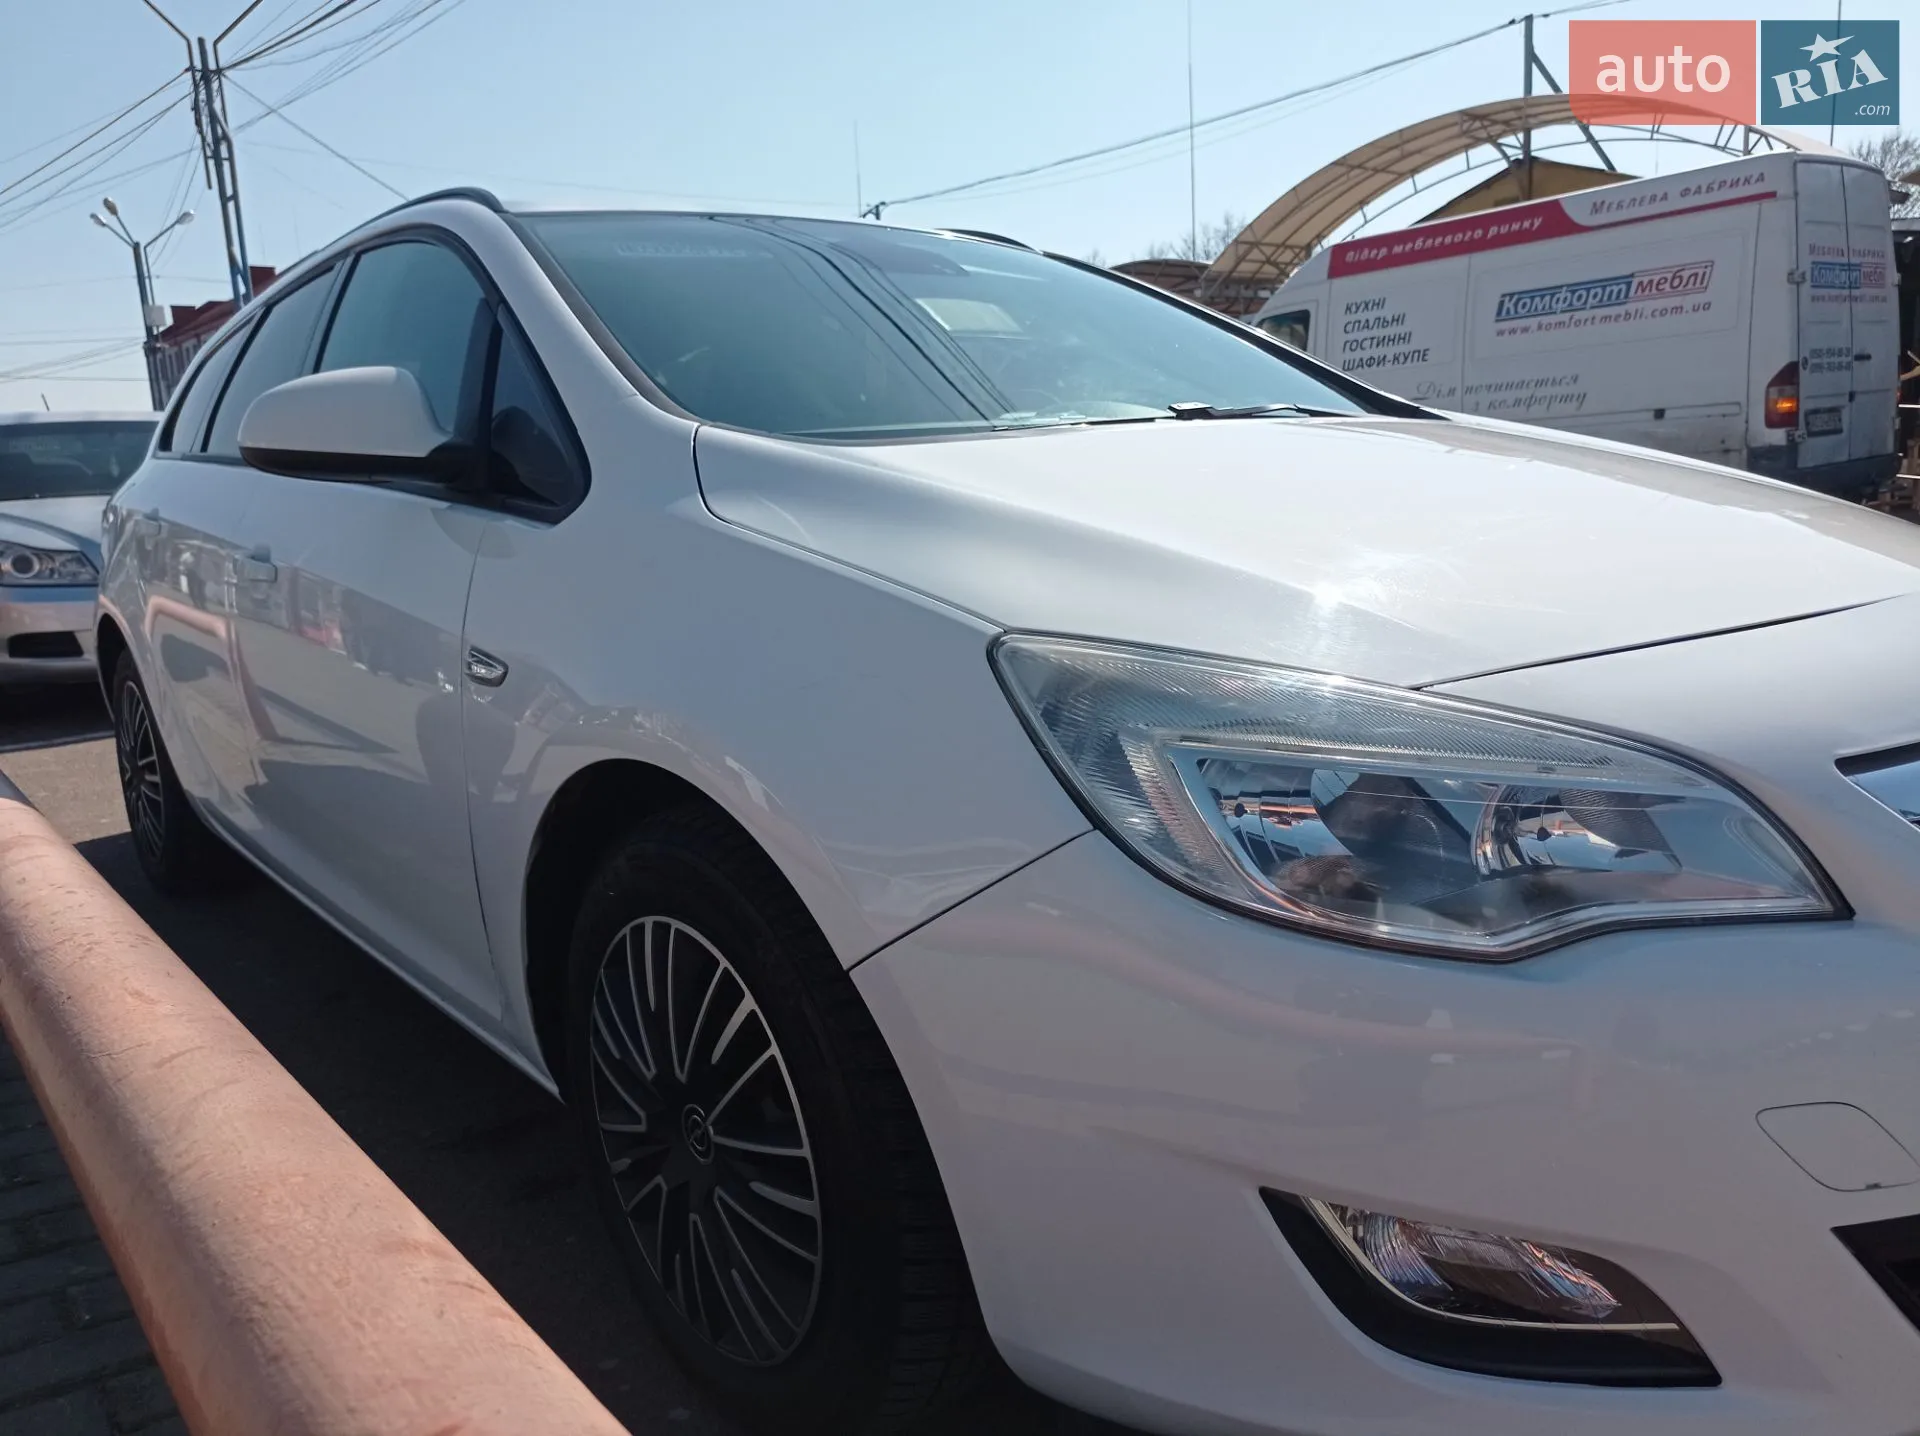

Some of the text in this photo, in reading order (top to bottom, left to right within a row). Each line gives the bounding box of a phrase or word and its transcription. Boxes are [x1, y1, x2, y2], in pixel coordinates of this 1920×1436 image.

[1487, 214, 1544, 240] ринку
[1344, 297, 1386, 316] КУХНІ
[1343, 313, 1406, 334] СПАЛЬНІ
[1342, 331, 1412, 353] ГОСТИННІ
[1342, 348, 1430, 372] ШАФИ-КУПЕ
